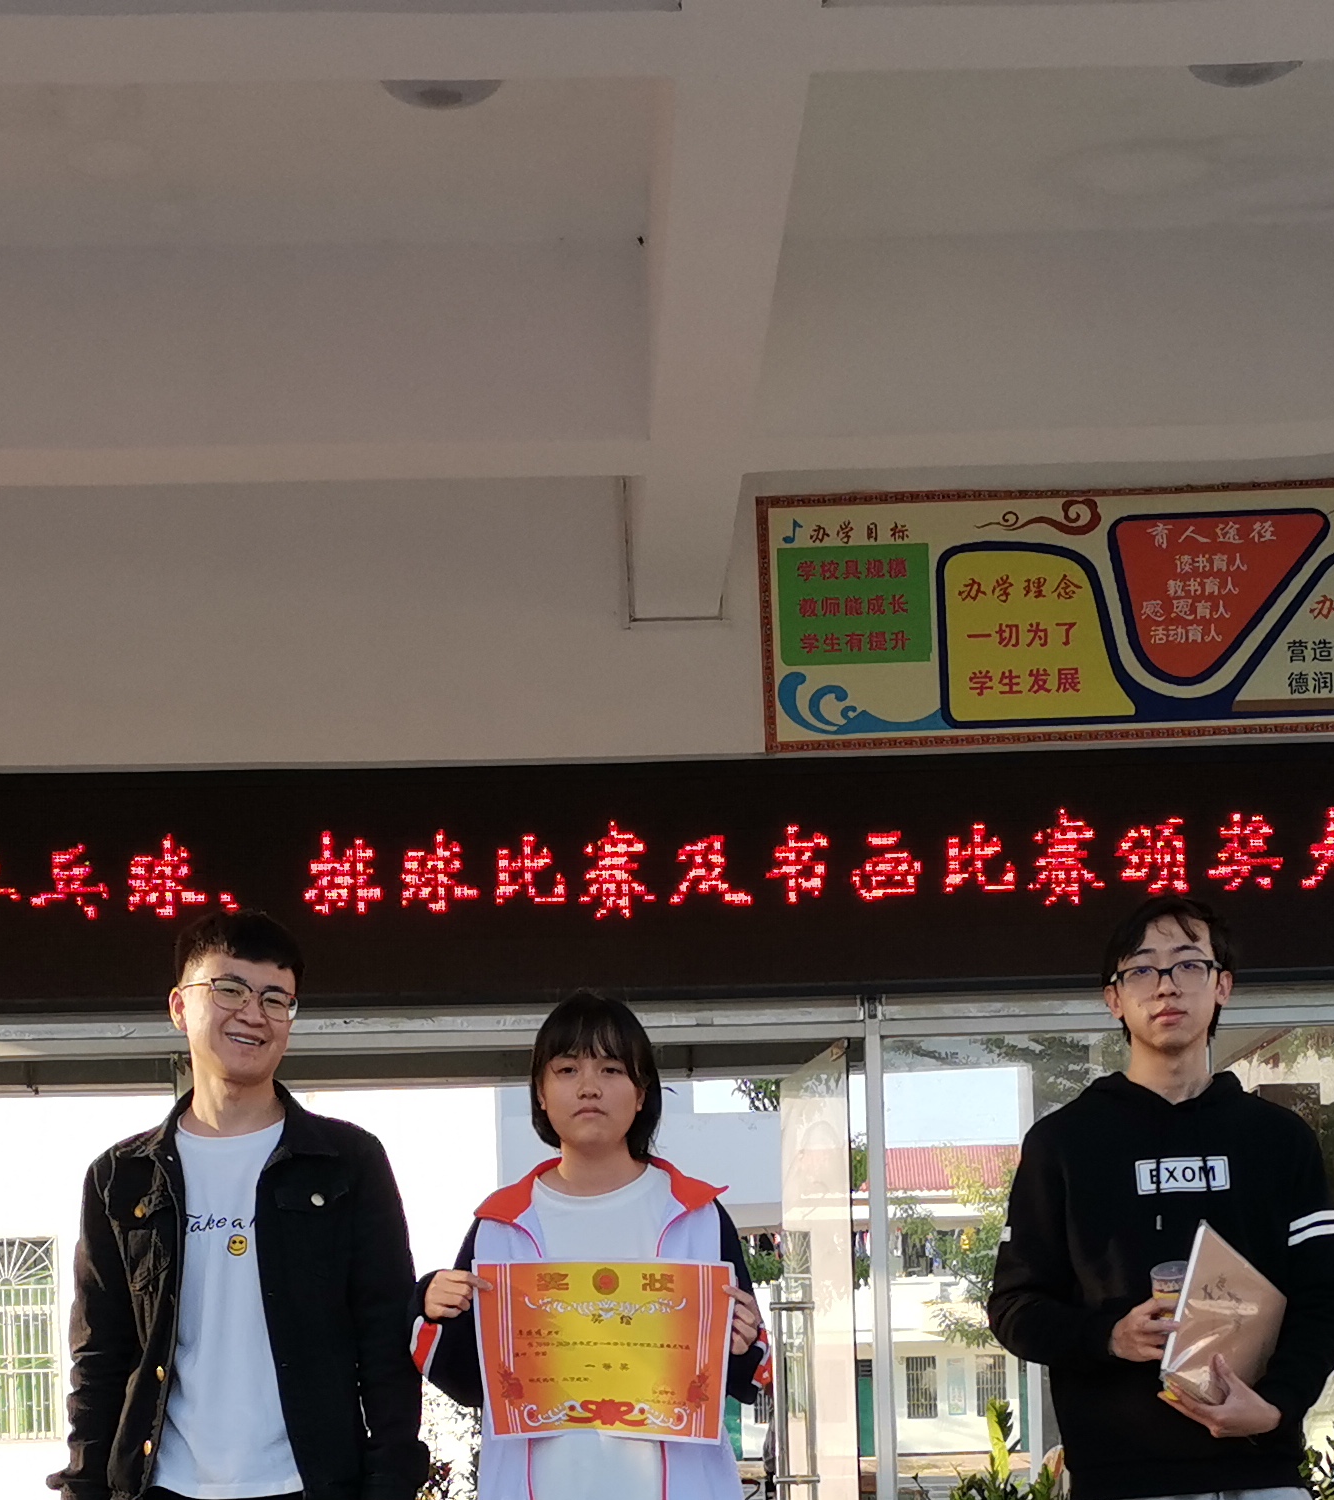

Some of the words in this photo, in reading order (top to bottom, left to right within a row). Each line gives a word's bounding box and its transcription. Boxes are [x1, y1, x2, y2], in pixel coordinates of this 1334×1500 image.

[809, 520, 910, 544] 办学目标
[1146, 520, 1278, 549] 育人途径
[797, 558, 907, 581] 学校具规模
[1175, 553, 1248, 574] 读书育人
[958, 574, 1083, 603] 办学理念
[1167, 576, 1239, 597] 教书育人
[799, 595, 909, 618] 教师能成长
[1141, 599, 1231, 620] 感恩育人
[800, 631, 911, 655] 学生有提升
[967, 622, 1078, 648] 一切为了
[1150, 624, 1222, 644] 活动育人
[969, 668, 1081, 696] 学生发展
[231, 1217, 246, 1230] a
